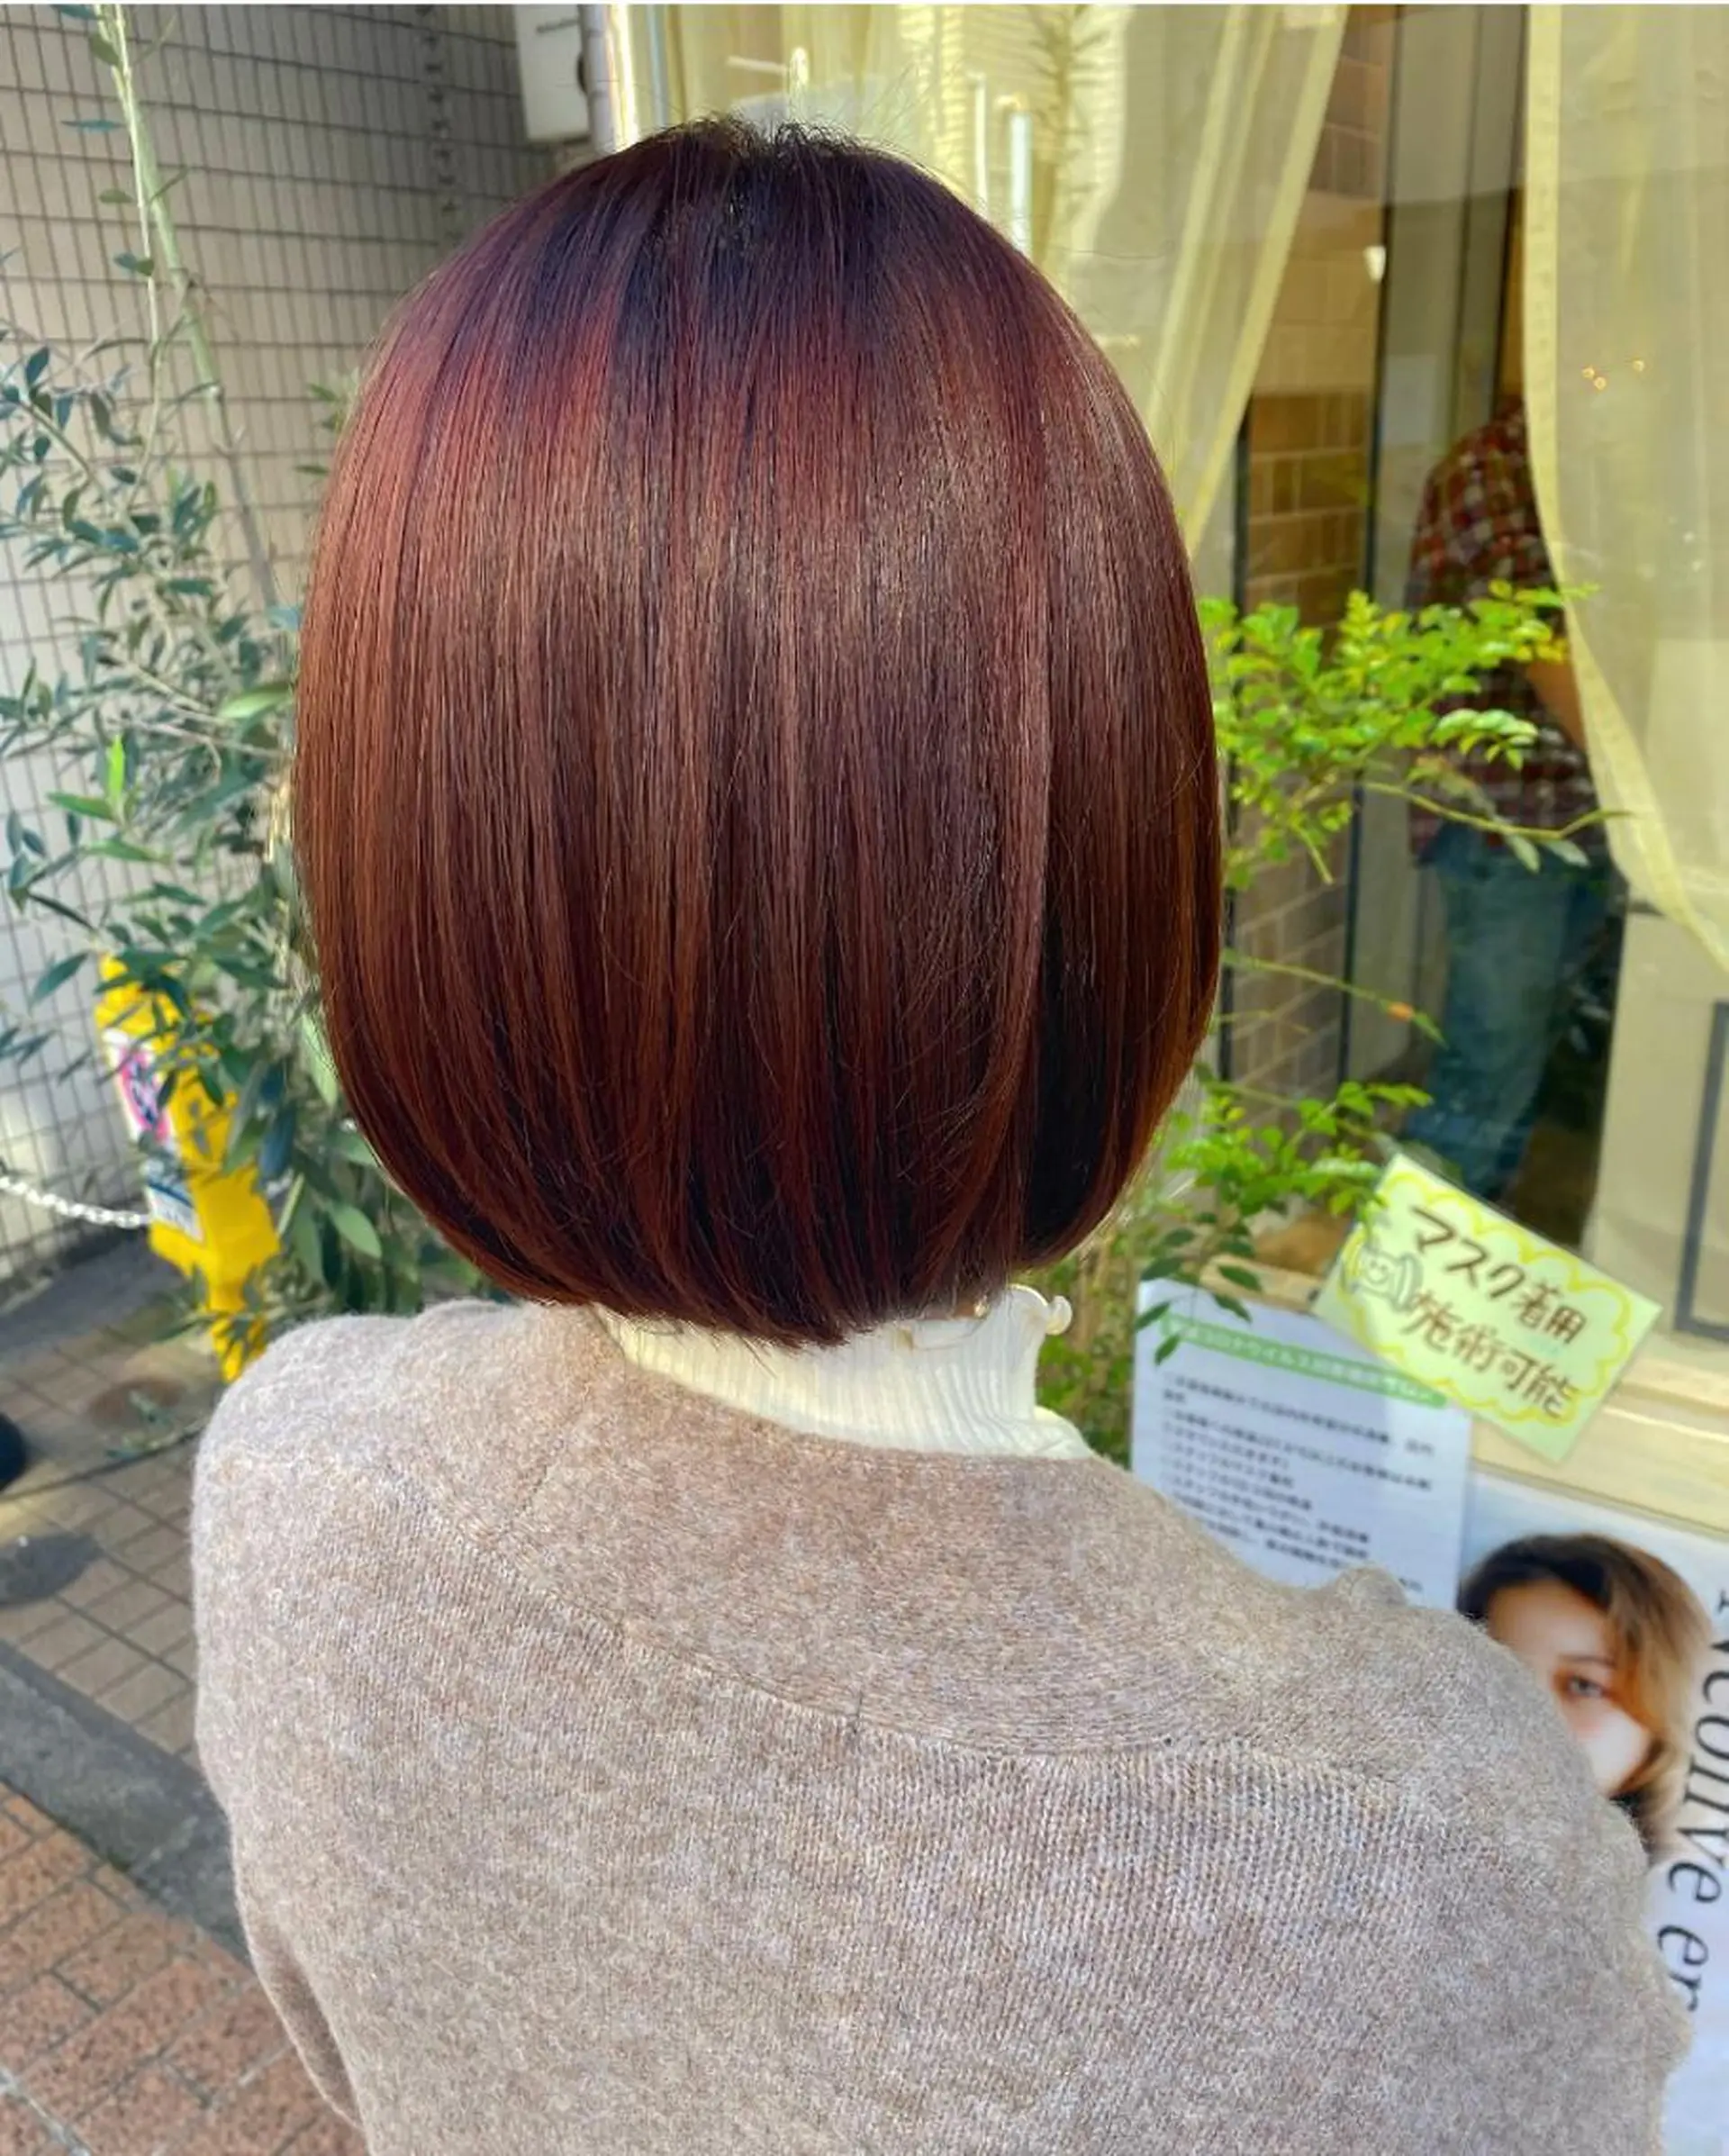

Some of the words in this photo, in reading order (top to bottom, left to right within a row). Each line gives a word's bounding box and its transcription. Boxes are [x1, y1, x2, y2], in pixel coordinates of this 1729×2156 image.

[1410, 1206, 1587, 1344] マスク着用
[1400, 1290, 1580, 1418] 施術可能
